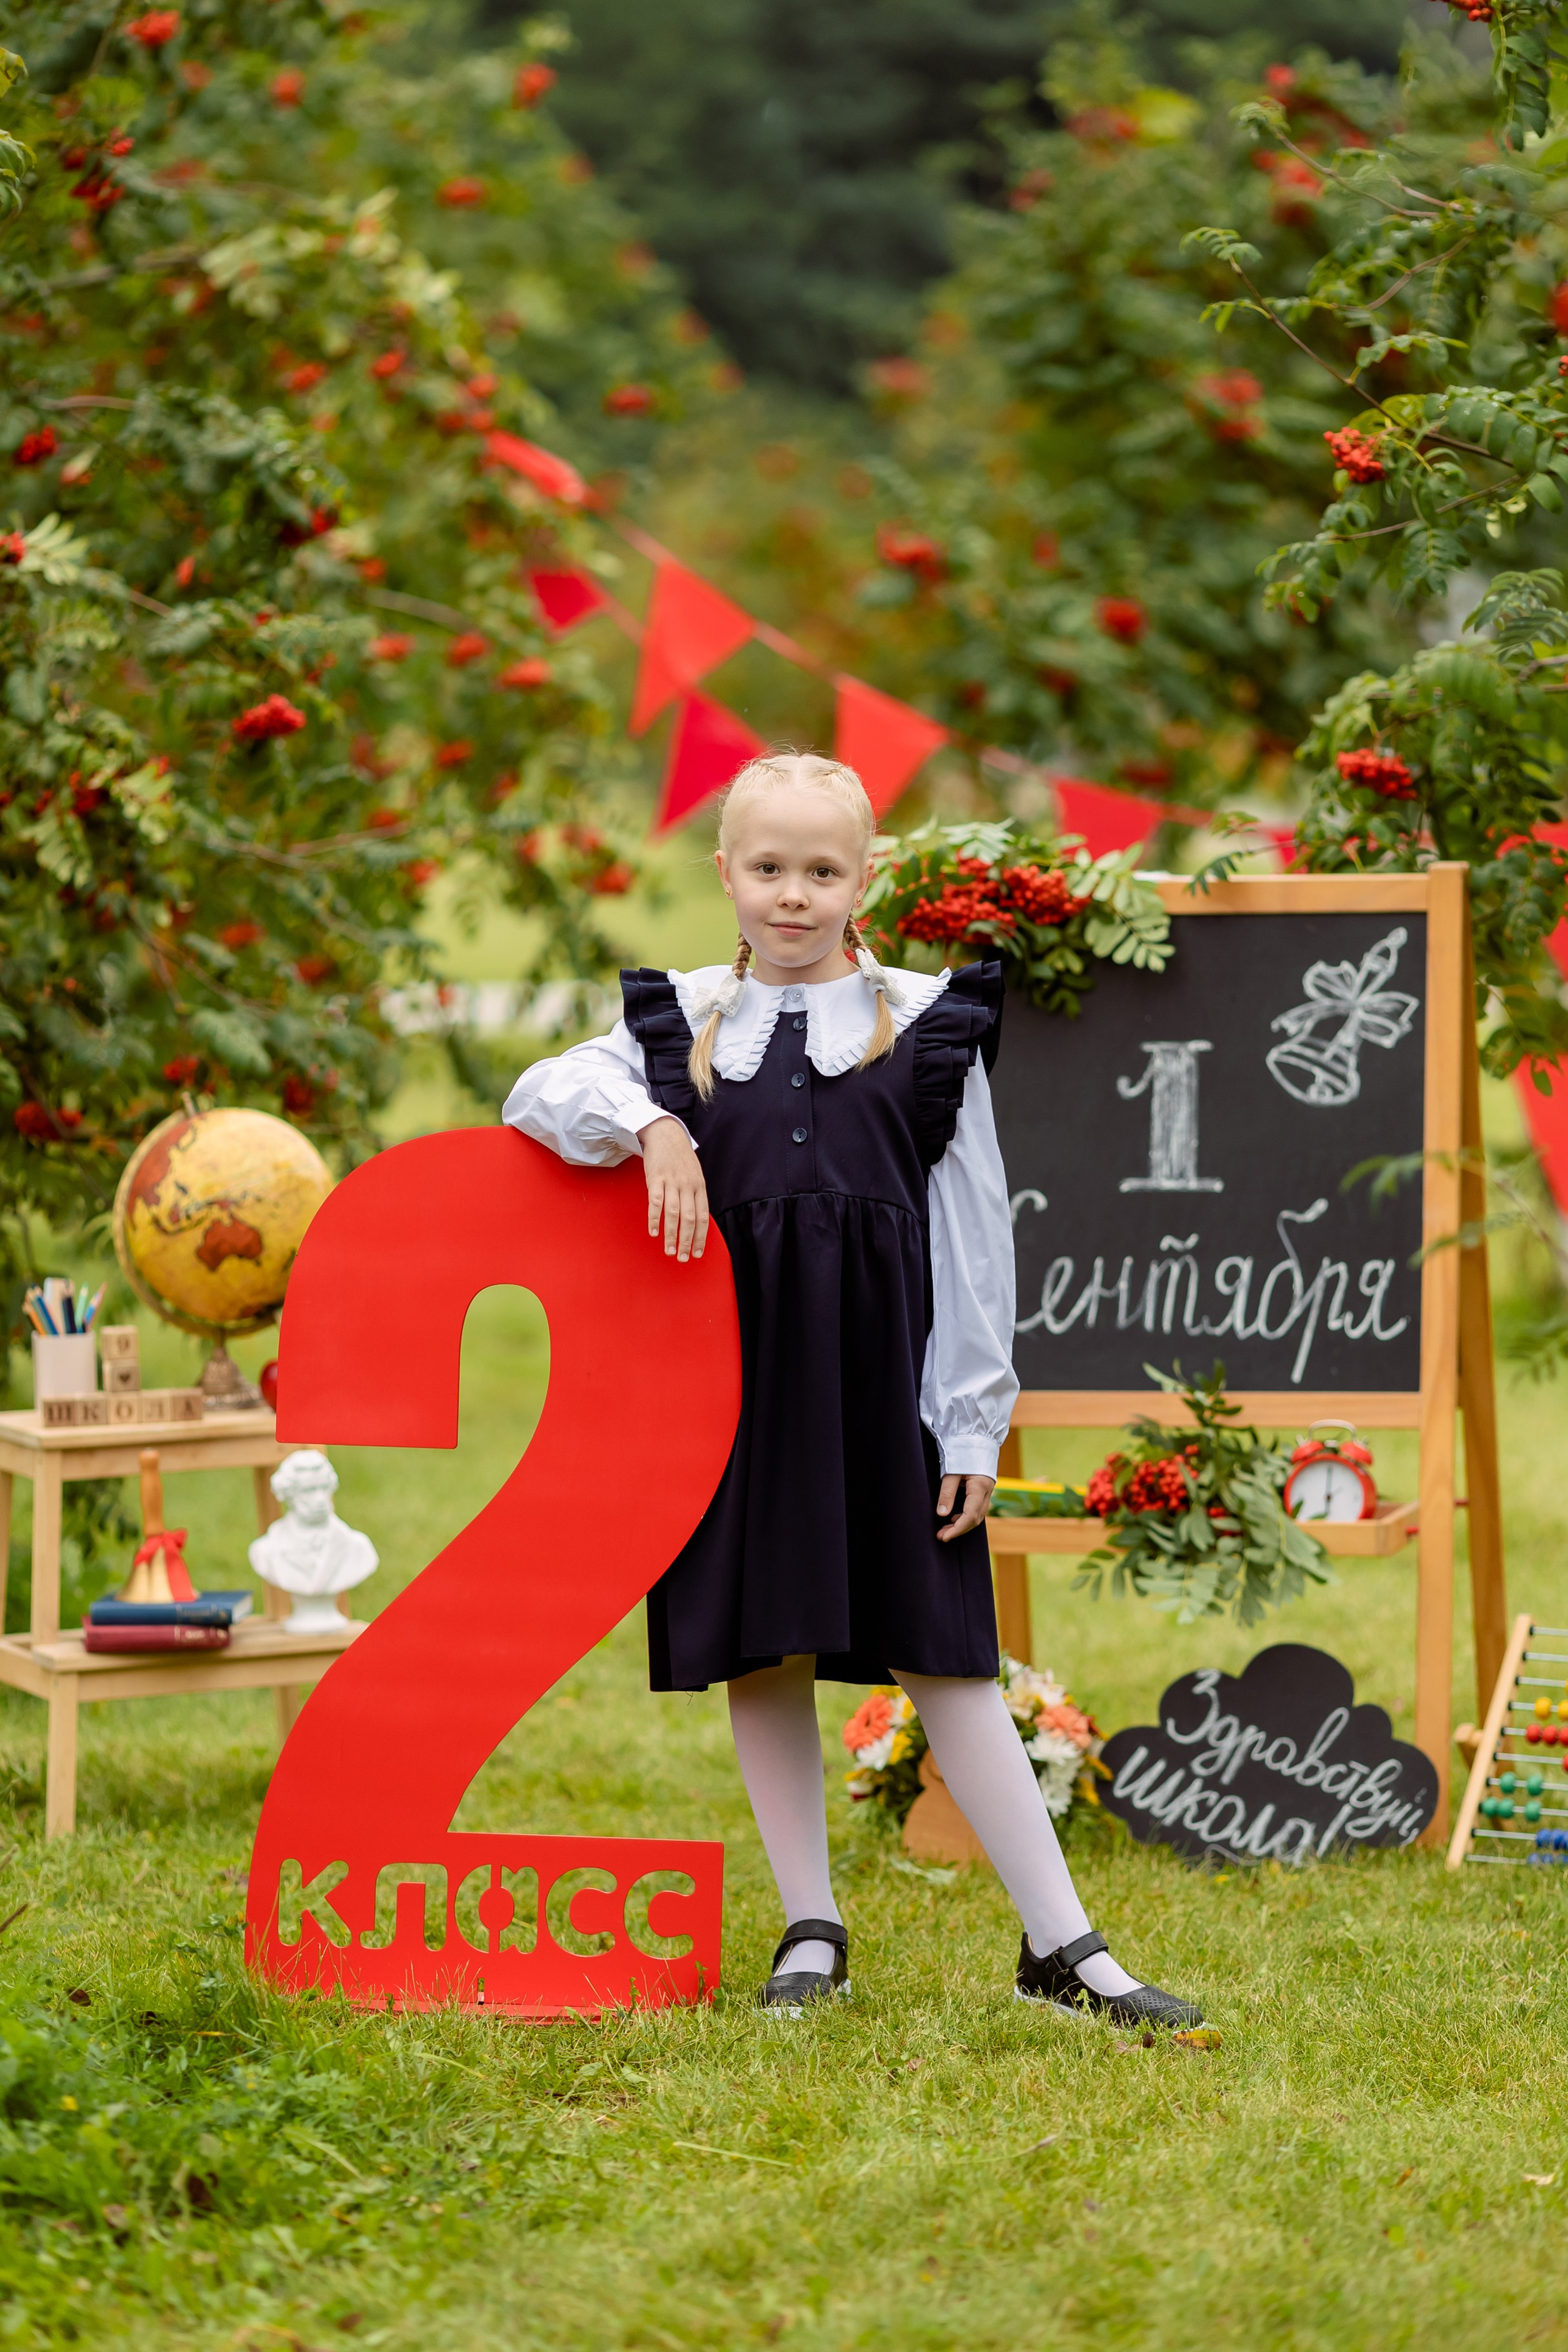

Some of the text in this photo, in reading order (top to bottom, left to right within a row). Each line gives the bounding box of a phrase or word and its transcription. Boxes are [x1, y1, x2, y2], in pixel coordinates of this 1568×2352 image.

[1116, 1040, 1224, 1193] 1
[47, 1398, 193, 1422] ШКОЛА
[244, 1126, 742, 2006] 2
